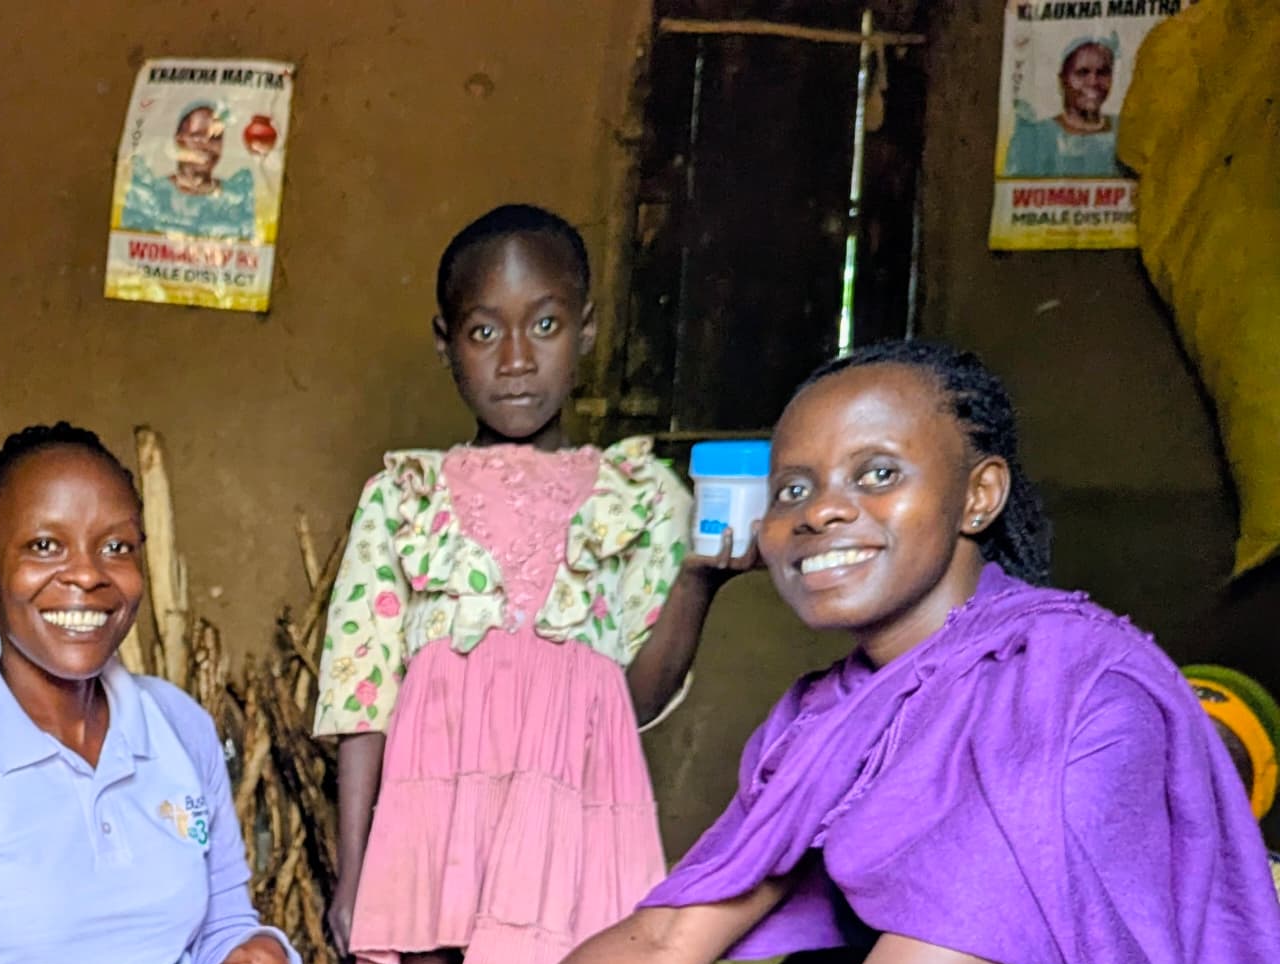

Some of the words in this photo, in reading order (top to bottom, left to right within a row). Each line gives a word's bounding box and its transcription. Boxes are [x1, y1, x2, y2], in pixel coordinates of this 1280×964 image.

[1017, 1, 1101, 21] KAUKHA
[1013, 187, 1090, 207] WOMAN
[1094, 187, 1126, 207] MP
